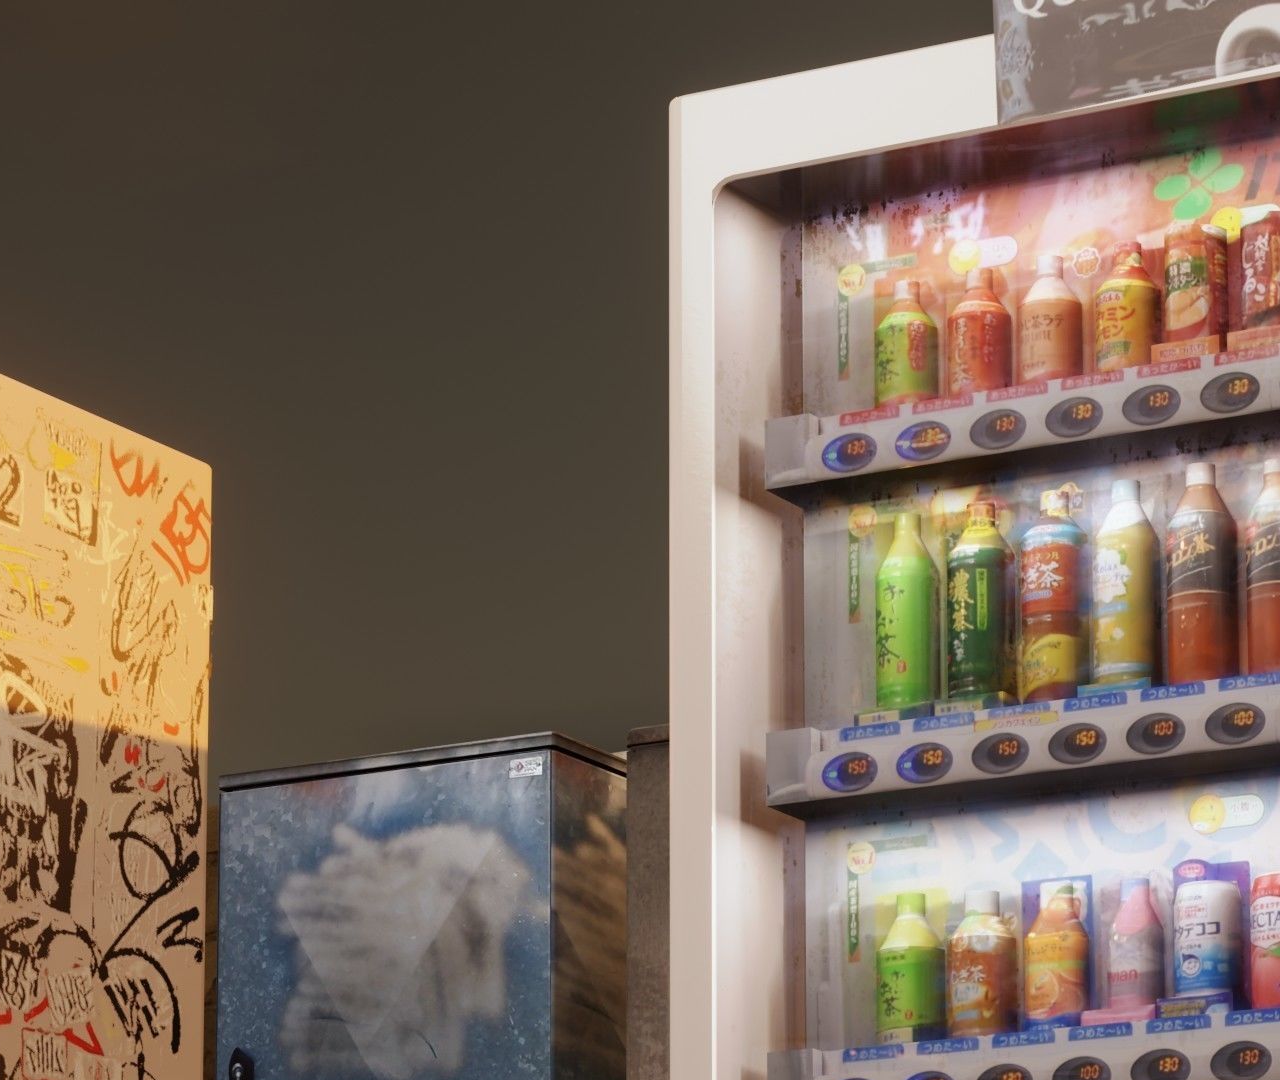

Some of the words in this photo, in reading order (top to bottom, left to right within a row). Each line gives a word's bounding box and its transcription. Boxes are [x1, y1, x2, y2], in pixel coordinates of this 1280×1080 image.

[1228, 379, 1249, 395] 130
[1149, 391, 1168, 407] 130
[1072, 404, 1093, 418] 130
[995, 417, 1015, 431] 130
[847, 440, 866, 455] 130
[1233, 710, 1255, 726] 100
[1153, 720, 1174, 737] 100
[1075, 729, 1096, 746] 150
[997, 739, 1018, 756] 150
[922, 749, 944, 766] 150
[847, 758, 867, 775] 150
[1159, 1057, 1179, 1072] 130
[1239, 1050, 1259, 1065] 130
[1079, 1064, 1099, 1080] 100
